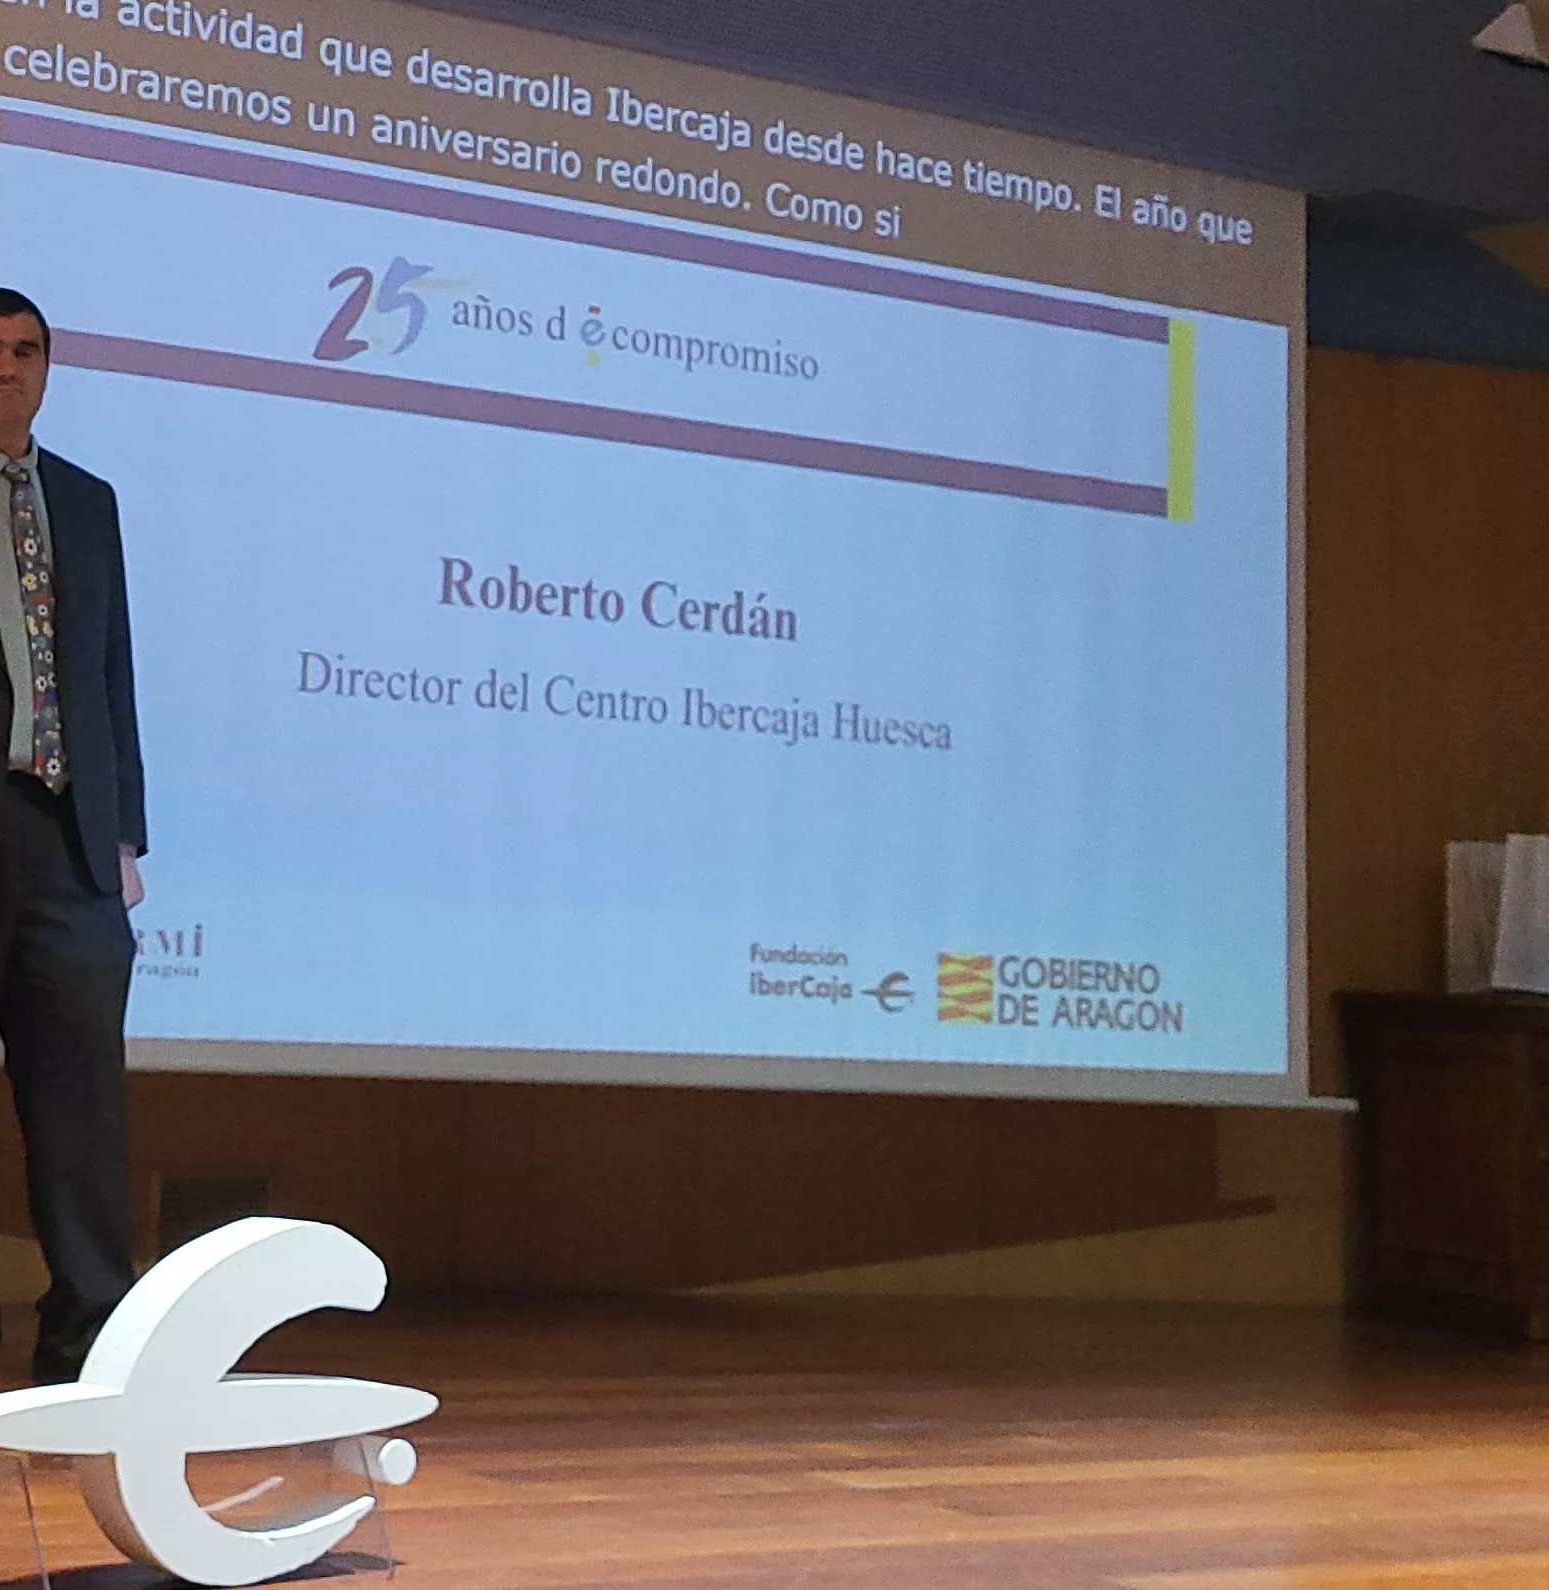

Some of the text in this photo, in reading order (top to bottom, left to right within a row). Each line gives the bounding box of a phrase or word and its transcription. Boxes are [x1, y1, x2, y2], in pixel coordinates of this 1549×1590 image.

[3, 42, 292, 127] celebraremos
[308, 104, 355, 137] un
[371, 112, 581, 179] aniversario
[594, 155, 752, 212] redondo.
[765, 182, 864, 234] Como
[874, 205, 901, 239] si
[117, 0, 303, 60] actividad
[319, 36, 392, 77] que
[406, 48, 592, 118] desarrolla
[606, 86, 752, 153] Ibercaja
[764, 120, 864, 172] desde
[875, 141, 952, 187] hace
[963, 161, 1082, 215] tiempo.
[1094, 183, 1122, 220] El
[1132, 193, 1187, 233] año
[1199, 214, 1253, 245] que
[313, 255, 435, 361] 25
[452, 293, 533, 337] años
[611, 321, 820, 380] compromiso
[439, 555, 798, 641] Roberto Cerdán
[298, 650, 953, 751] Director del Centro Ibercaja Huesca
[997, 955, 1161, 995] GOBIERNO
[998, 995, 1039, 1027] DE
